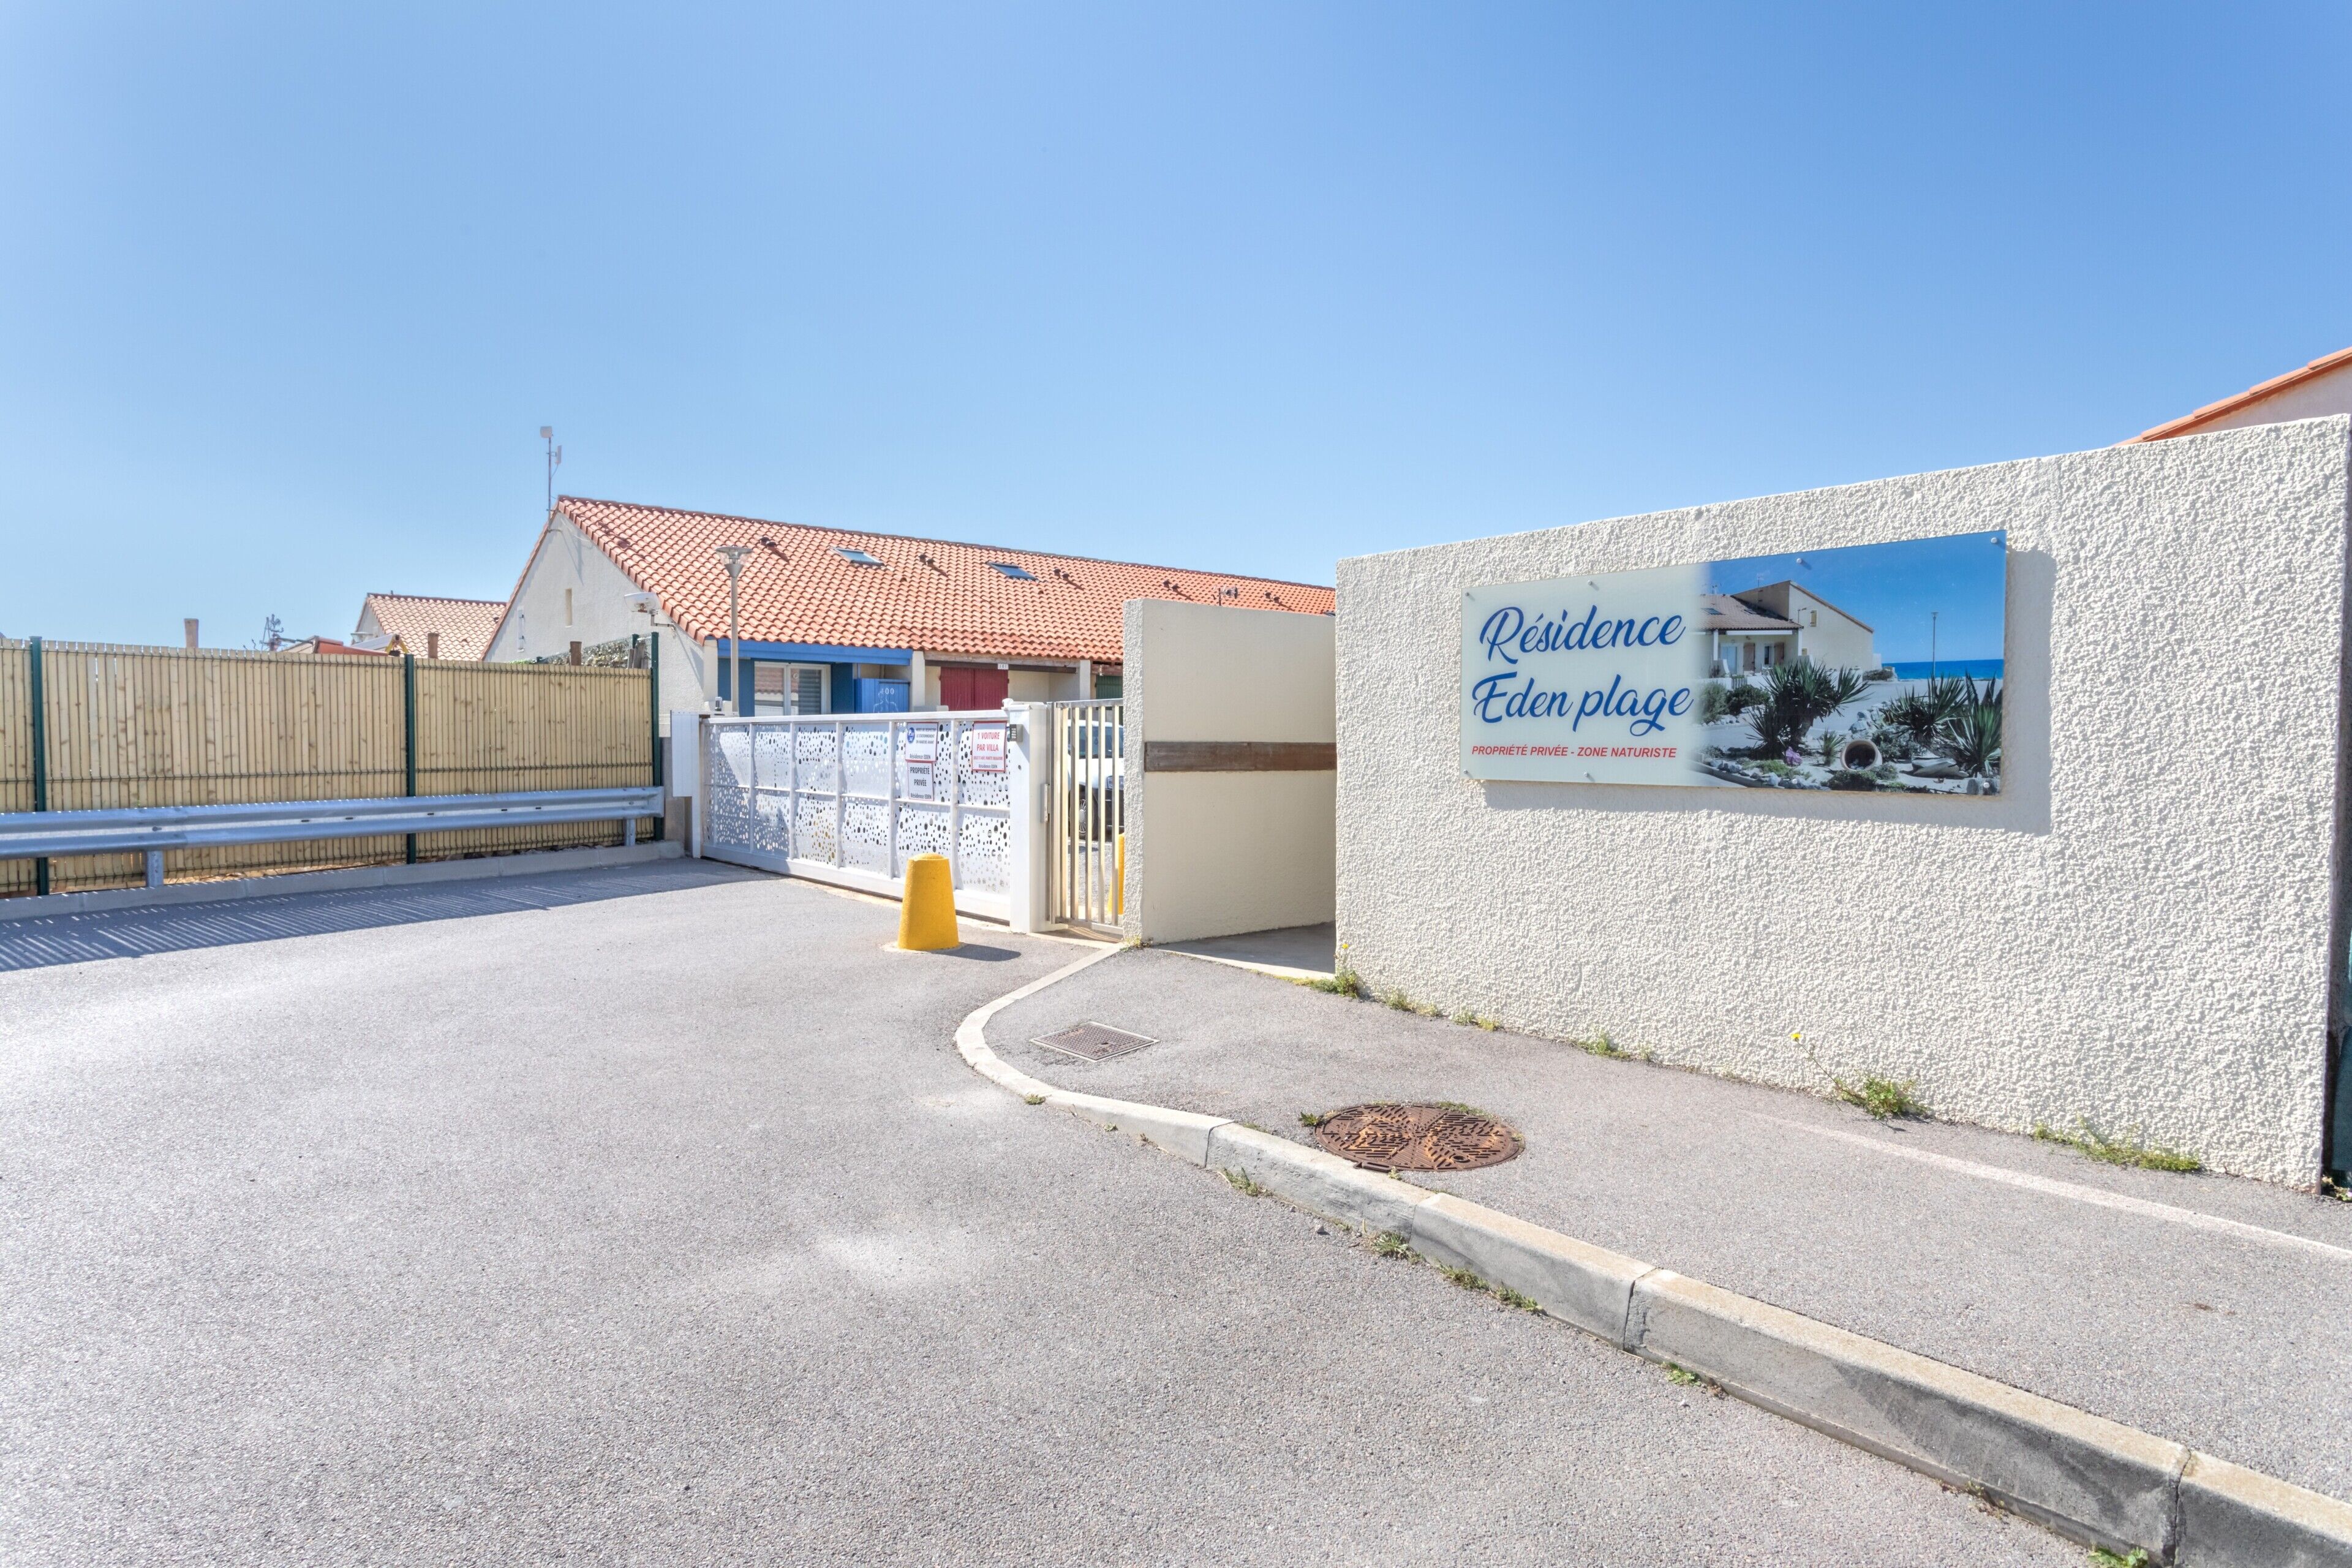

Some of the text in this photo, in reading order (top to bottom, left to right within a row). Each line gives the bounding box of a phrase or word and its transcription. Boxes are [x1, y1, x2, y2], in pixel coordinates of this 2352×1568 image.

[1479, 605, 1686, 665] Résidence
[1472, 671, 1694, 737] Eden plage
[1472, 744, 1528, 756] PROPRIÉTÉ
[1530, 745, 1568, 756] PRIVÉE
[1577, 747, 1608, 757] ZONE
[1610, 747, 1677, 758] NATURISTE
[910, 766, 930, 774] PROPRIÉTÉ
